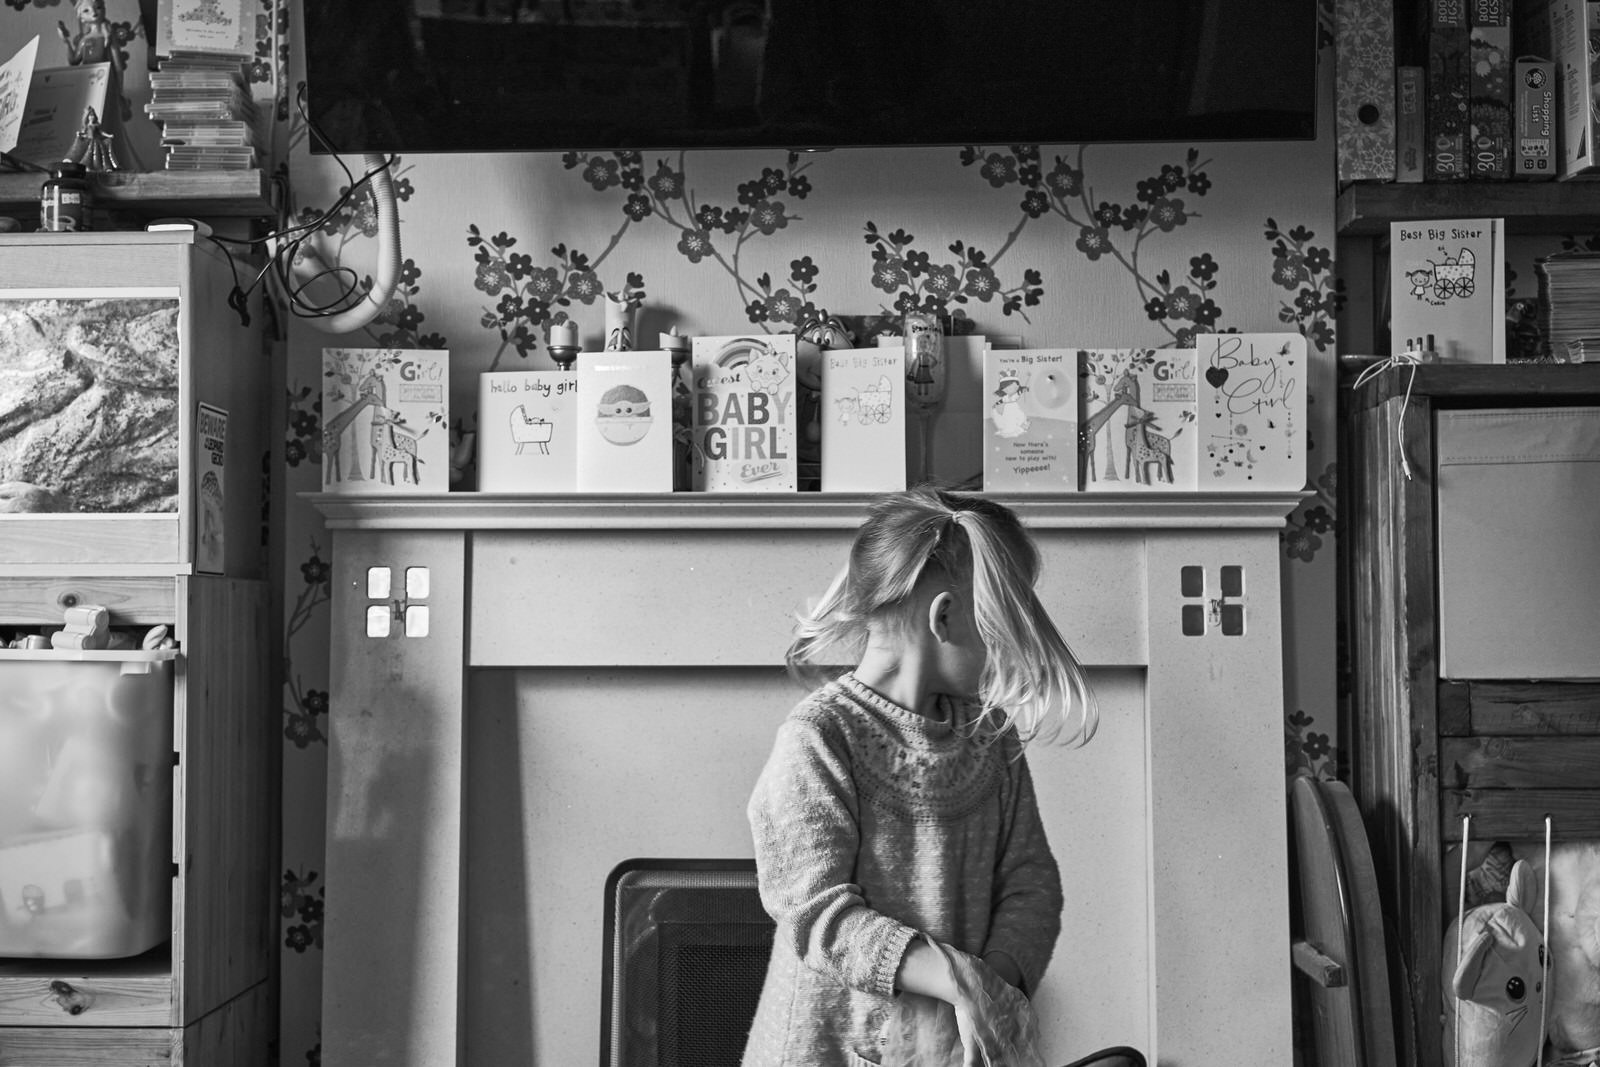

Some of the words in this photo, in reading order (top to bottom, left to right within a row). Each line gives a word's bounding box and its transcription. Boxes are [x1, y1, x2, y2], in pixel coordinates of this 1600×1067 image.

[1532, 104, 1541, 123] List
[1541, 91, 1552, 136] Shopping
[1436, 152, 1455, 172] 30
[1477, 152, 1495, 171] 30
[1400, 229, 1423, 241] Best
[1428, 228, 1445, 240] Big
[1451, 228, 1483, 240] Sister
[1021, 355, 1033, 365] Big
[1036, 354, 1063, 363] Sister!
[1210, 337, 1280, 394] Baby
[490, 379, 518, 394] hello
[525, 378, 551, 398] baby
[557, 379, 578, 395] girl
[1221, 378, 1296, 414] Girl
[697, 391, 793, 426] BABY
[704, 426, 788, 461] GIRL
[1027, 455, 1040, 463] play
[740, 462, 781, 478] Ever
